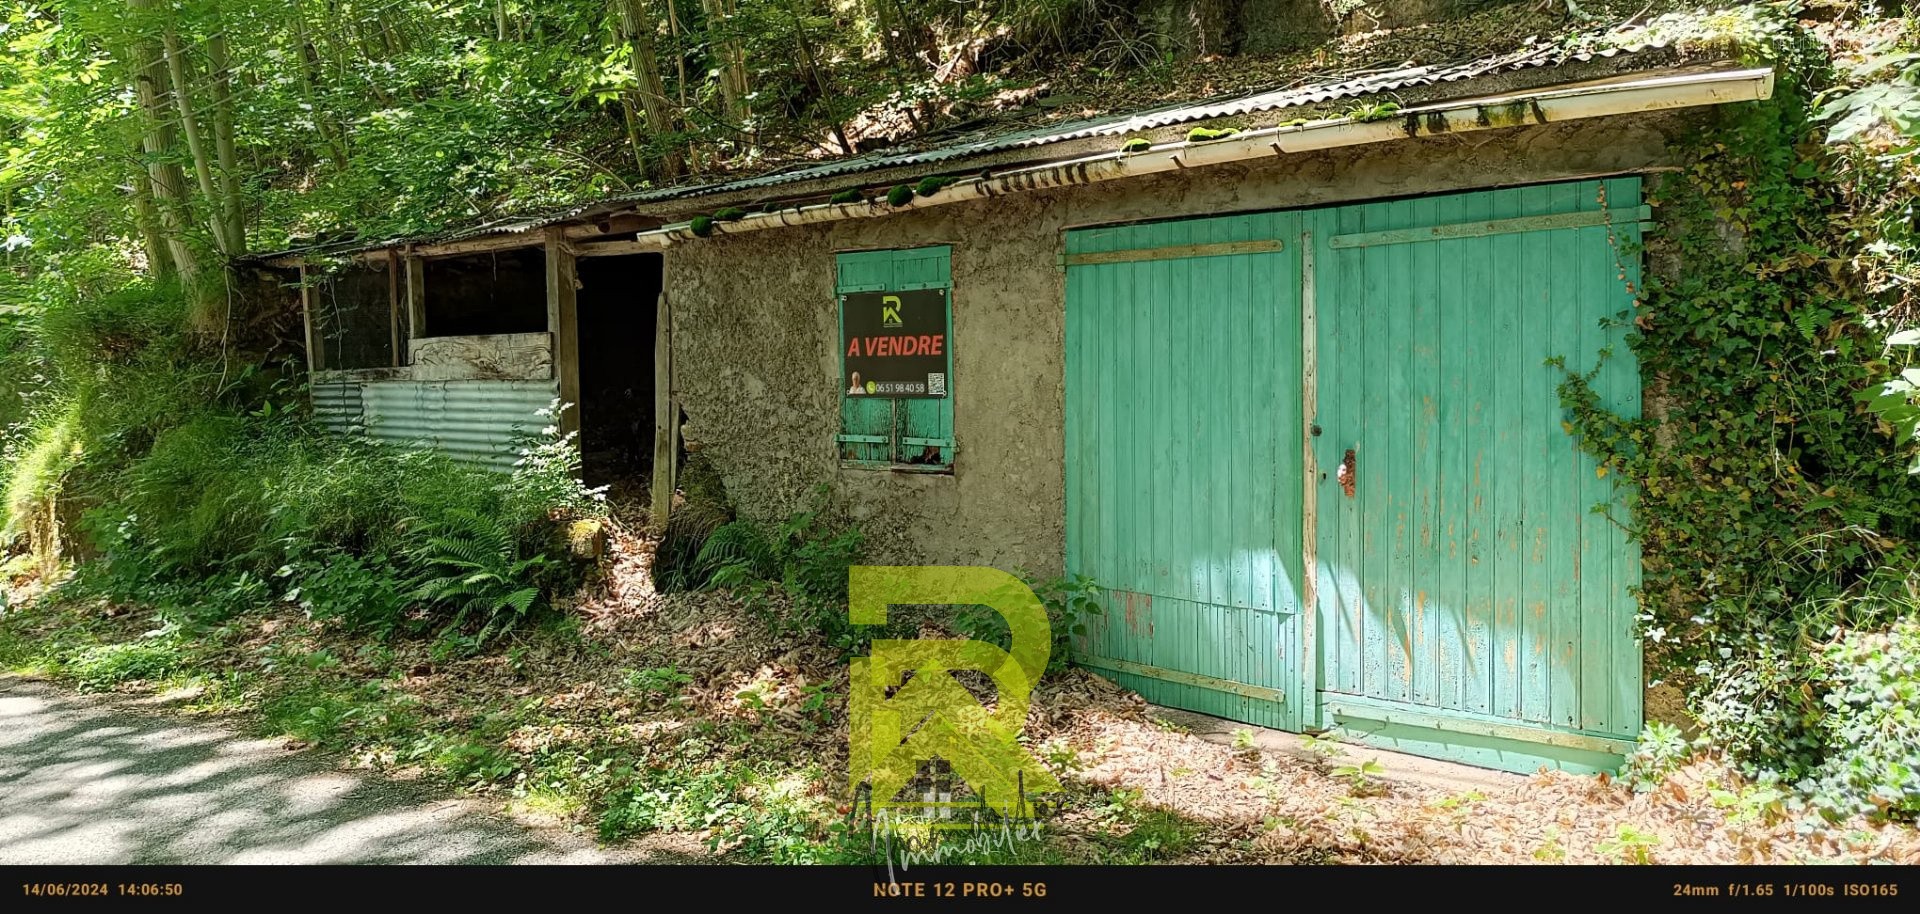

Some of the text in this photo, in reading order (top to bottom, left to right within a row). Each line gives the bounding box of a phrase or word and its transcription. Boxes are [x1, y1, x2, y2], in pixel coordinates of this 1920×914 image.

[847, 334, 944, 357] A VENDRE
[875, 383, 925, 393] 06 51 98 40 58
